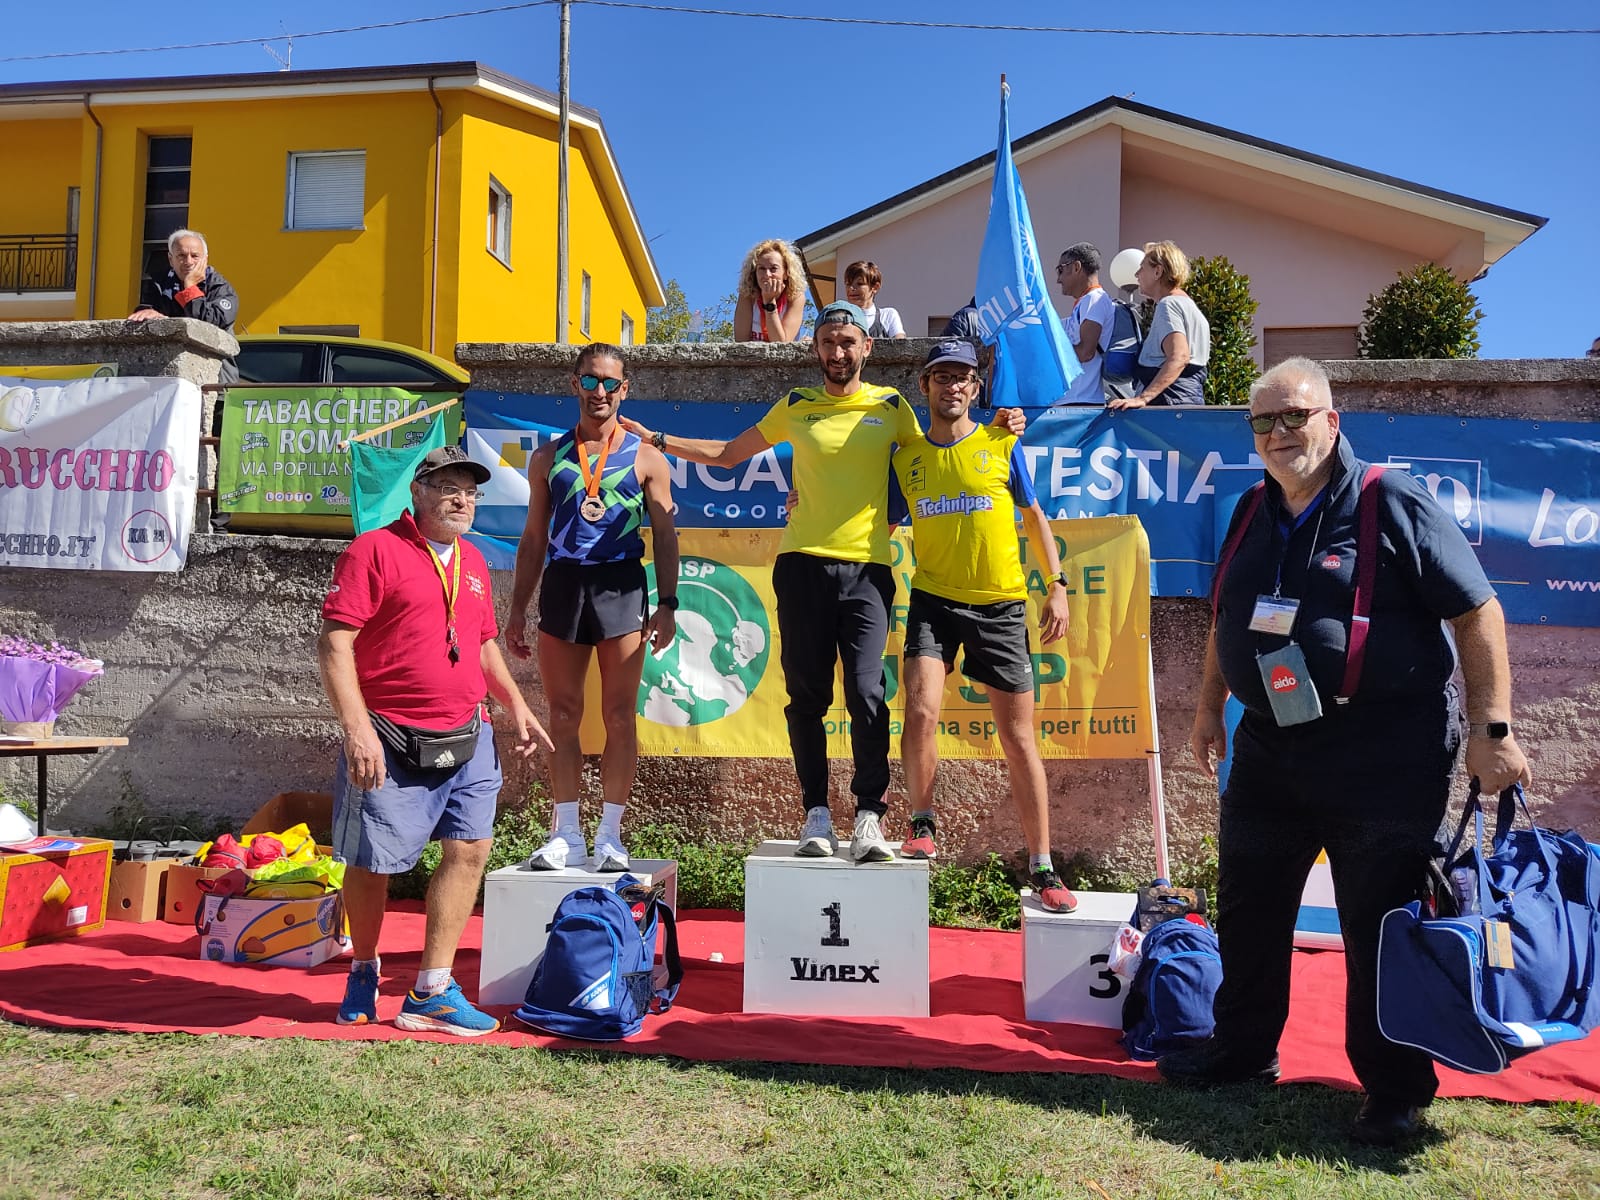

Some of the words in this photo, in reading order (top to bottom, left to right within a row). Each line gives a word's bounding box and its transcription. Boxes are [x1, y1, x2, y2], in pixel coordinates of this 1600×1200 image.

[243, 399, 431, 424] TABACCHERIA
[241, 462, 268, 476] VIA
[273, 462, 338, 477] POPILIA
[266, 491, 313, 502] LOTTO
[321, 486, 338, 499] 10
[917, 492, 992, 516] Technipes
[678, 560, 716, 579] ISP
[1273, 675, 1297, 689] aido
[1041, 718, 1080, 739] per
[1089, 714, 1136, 735] tutti
[820, 902, 850, 947] 1
[790, 957, 880, 983] Vinex
[1089, 954, 1122, 999] 3
